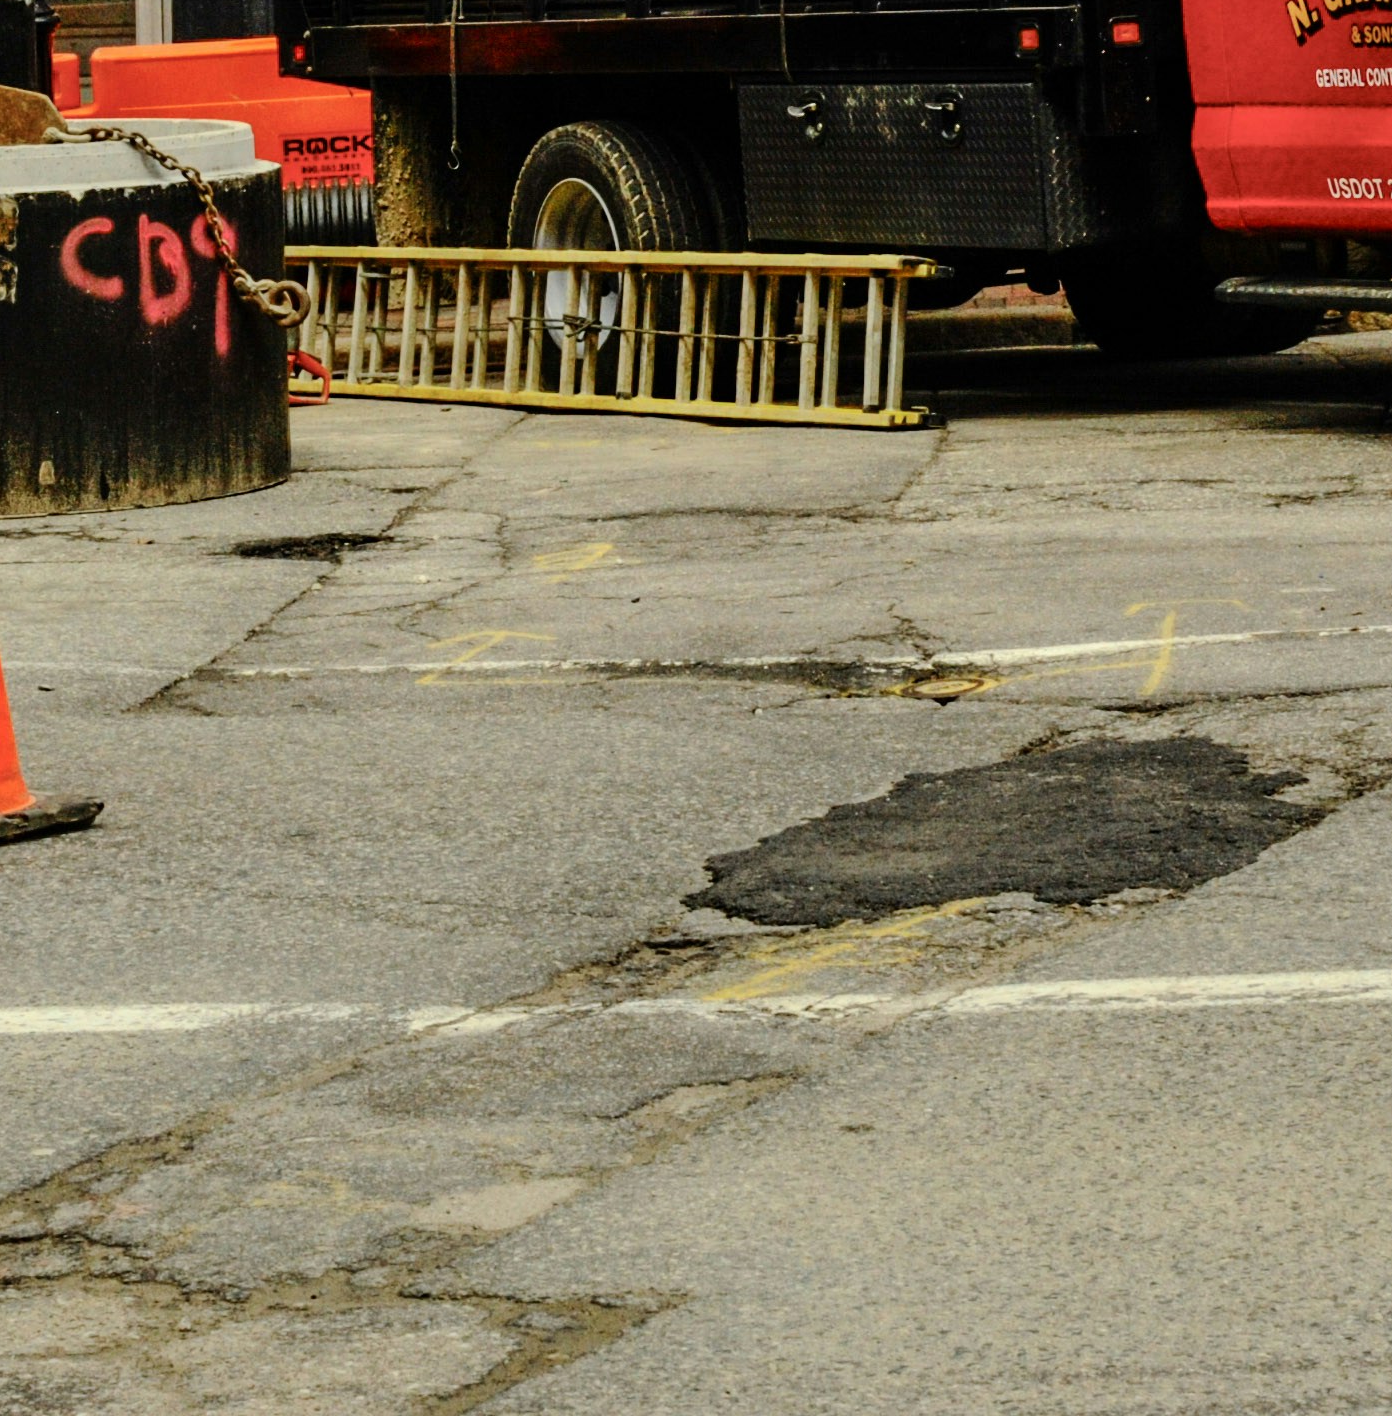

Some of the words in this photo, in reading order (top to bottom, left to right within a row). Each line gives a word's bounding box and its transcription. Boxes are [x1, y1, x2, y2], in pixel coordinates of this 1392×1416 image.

[1350, 24, 1362, 46] &
[1315, 68, 1365, 88] GENERAL
[282, 134, 372, 156] ROCK
[1327, 177, 1383, 200] USDOT
[59, 213, 240, 360] CD9
